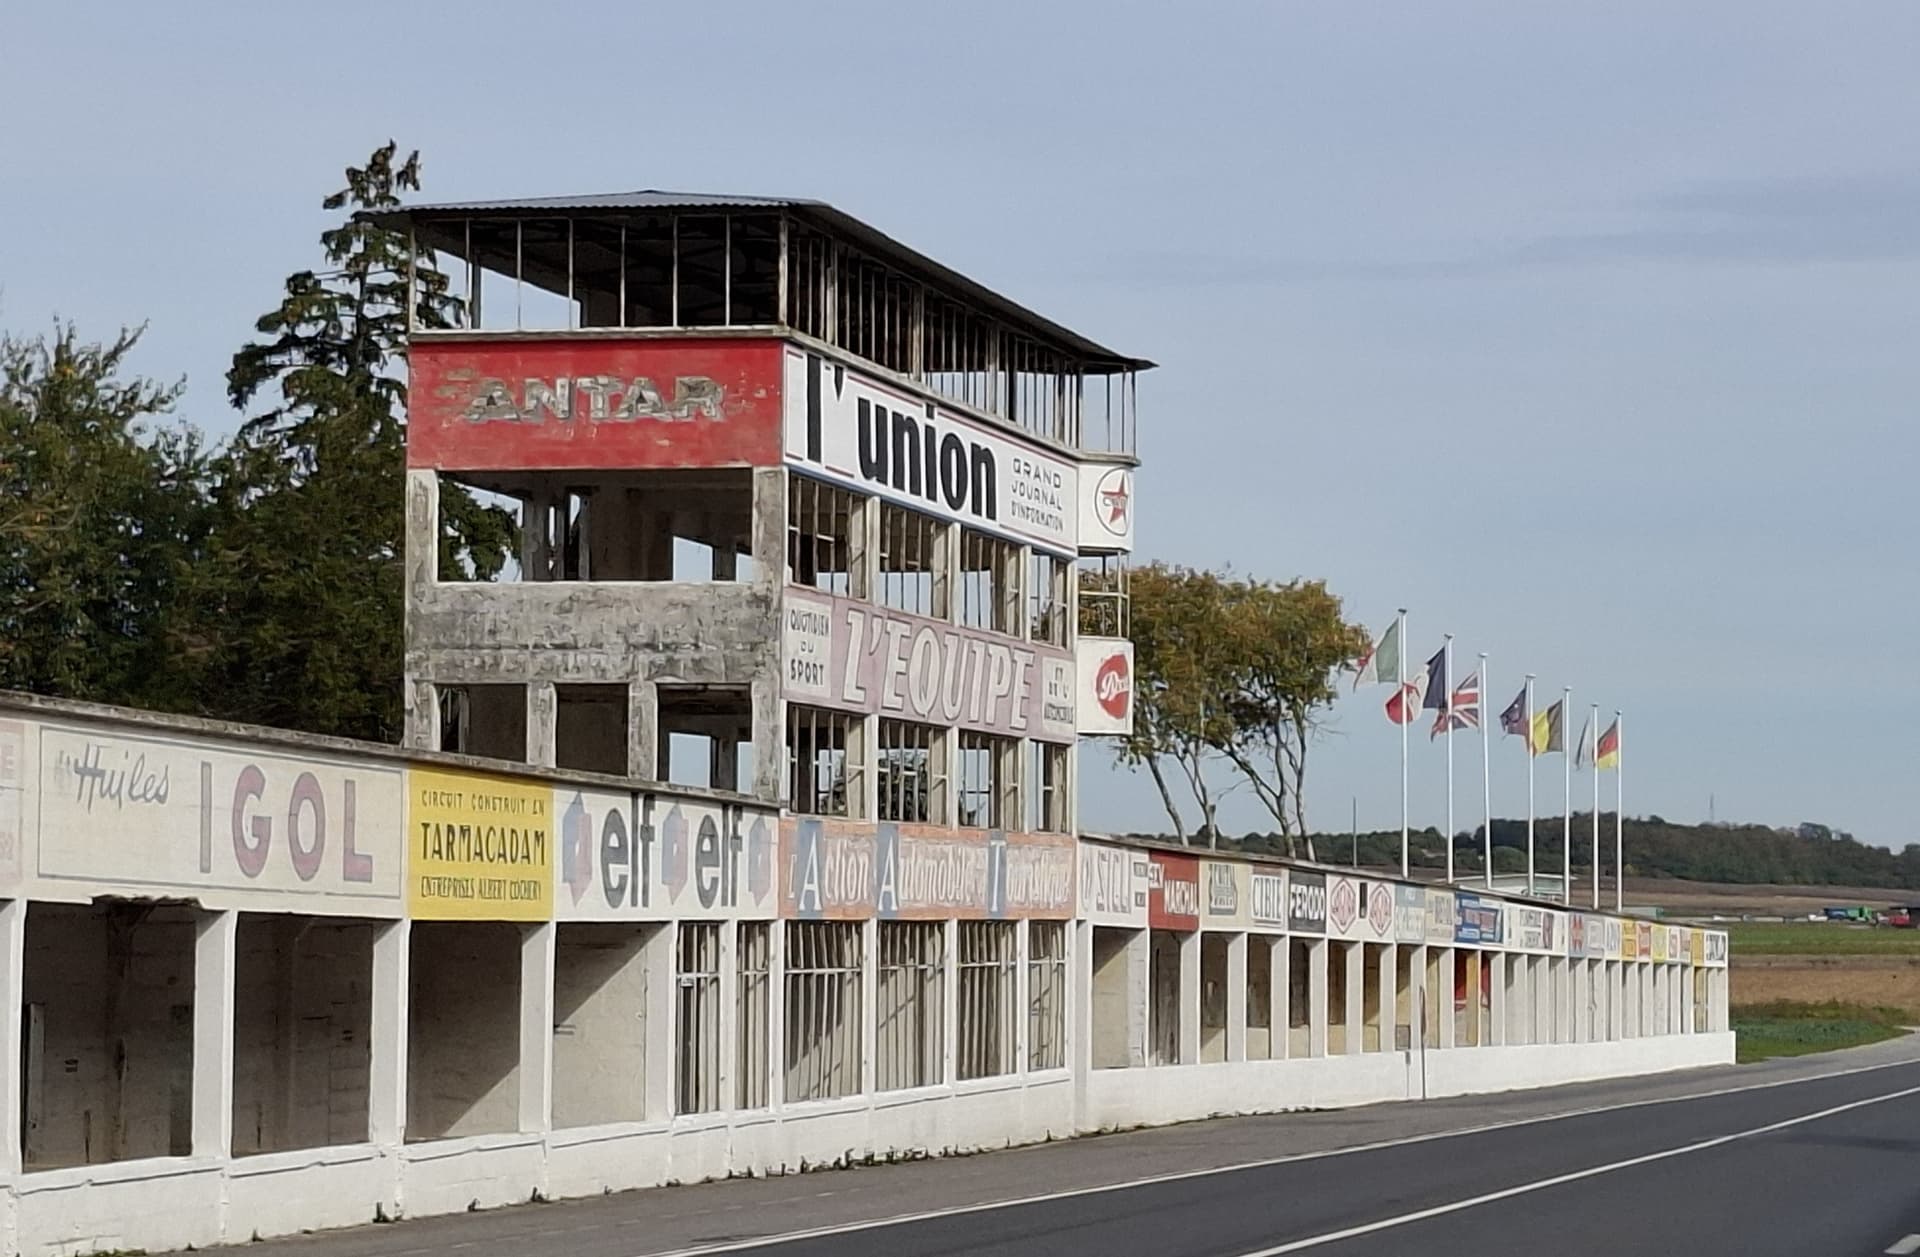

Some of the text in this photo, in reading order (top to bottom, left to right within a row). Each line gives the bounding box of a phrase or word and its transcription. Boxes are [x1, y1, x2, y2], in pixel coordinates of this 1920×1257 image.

[464, 375, 726, 423] ANTAR
[806, 354, 997, 521] l'union
[1011, 480, 1063, 511] JOURNAL
[1012, 457, 1062, 489] GRAND
[790, 658, 825, 686] SPORT
[842, 610, 1035, 731] L'EQUIPE
[199, 760, 374, 883] IGOL
[421, 789, 463, 810] CIRCUIT
[471, 793, 526, 815] CONSTRUIT
[421, 822, 546, 867] TARMACADAM
[600, 791, 743, 910] elf elf
[1289, 883, 1326, 921] FERODO
